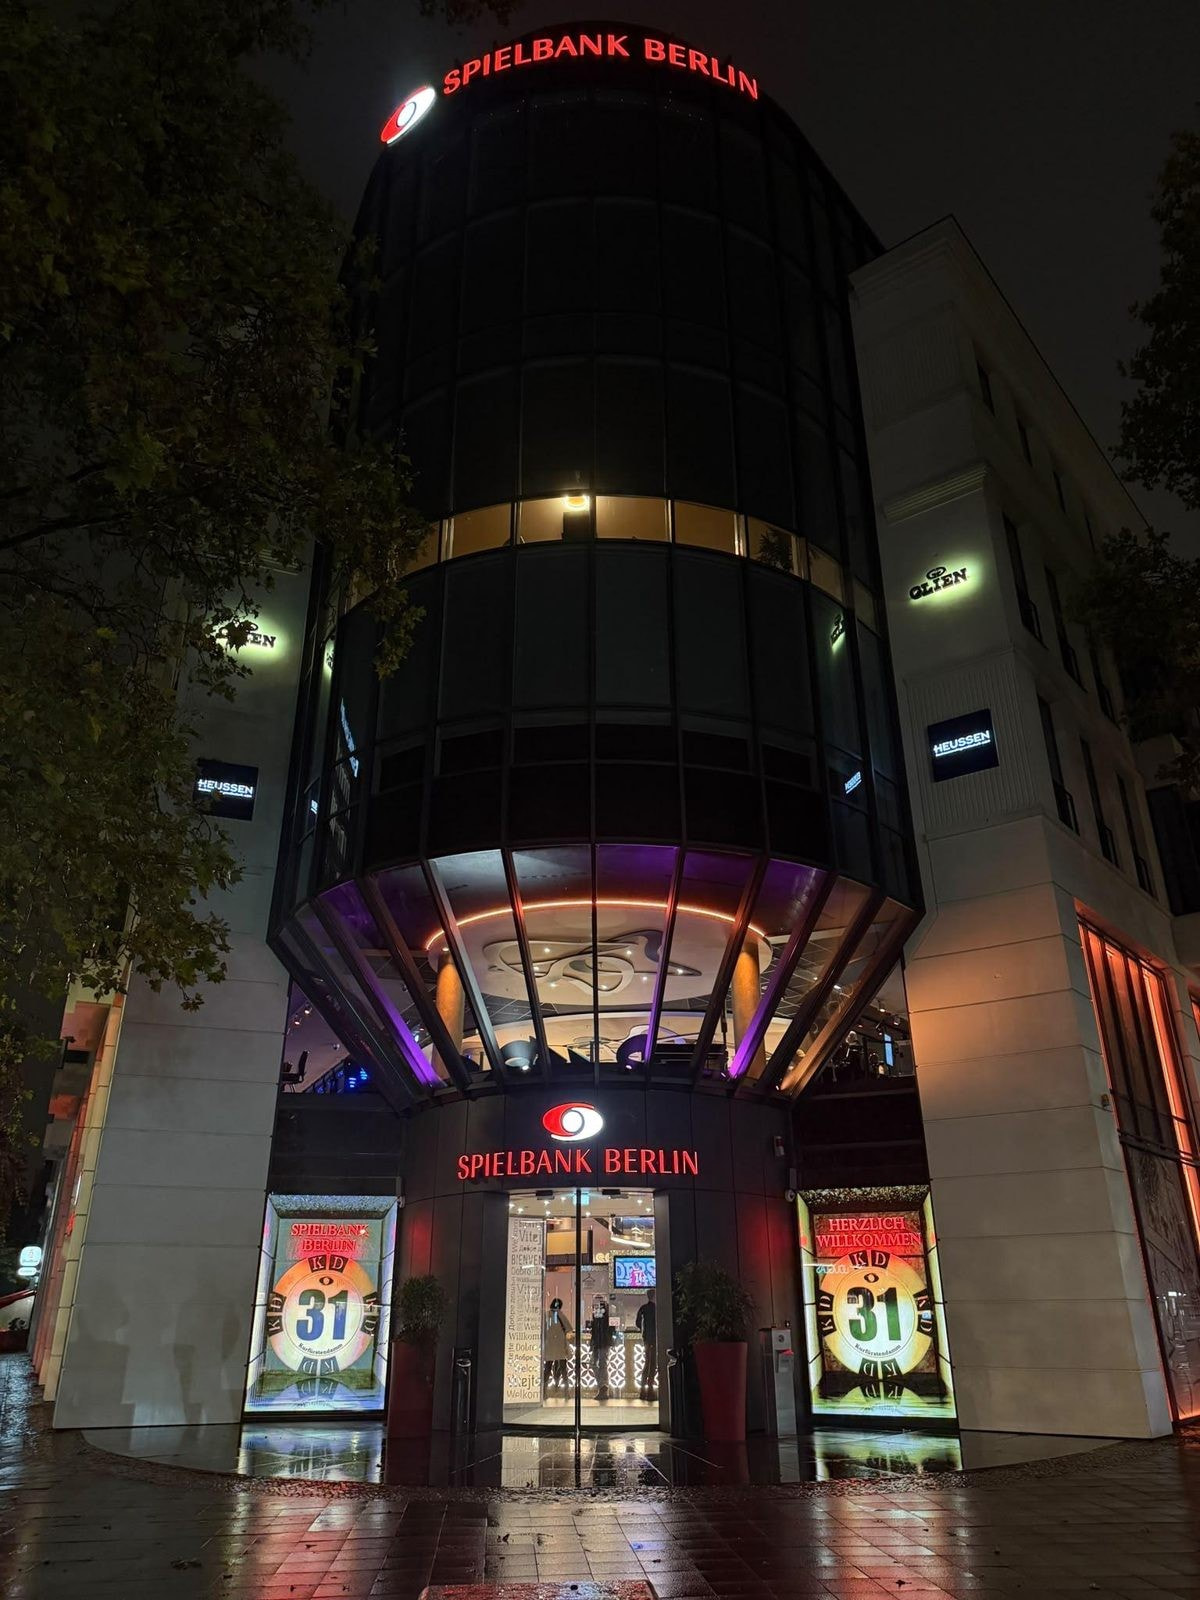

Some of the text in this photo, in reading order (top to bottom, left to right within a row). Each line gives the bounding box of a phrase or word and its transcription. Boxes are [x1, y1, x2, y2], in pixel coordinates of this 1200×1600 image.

[442, 33, 760, 101] SPIELBANK BERLIN
[933, 729, 991, 754] HEUSSEN
[197, 778, 255, 796] HEUSSEN
[457, 1148, 700, 1180] SPIELBANK BERLIN
[290, 1223, 370, 1237] SPIELBANK
[829, 1216, 906, 1232] HERZLICH
[302, 1238, 356, 1252] BERLIN
[815, 1232, 922, 1248] WILLKOMMEN
[295, 1288, 350, 1342] 31
[847, 1286, 902, 1342] 31
[854, 1343, 902, 1357] Kurfürstendamm
